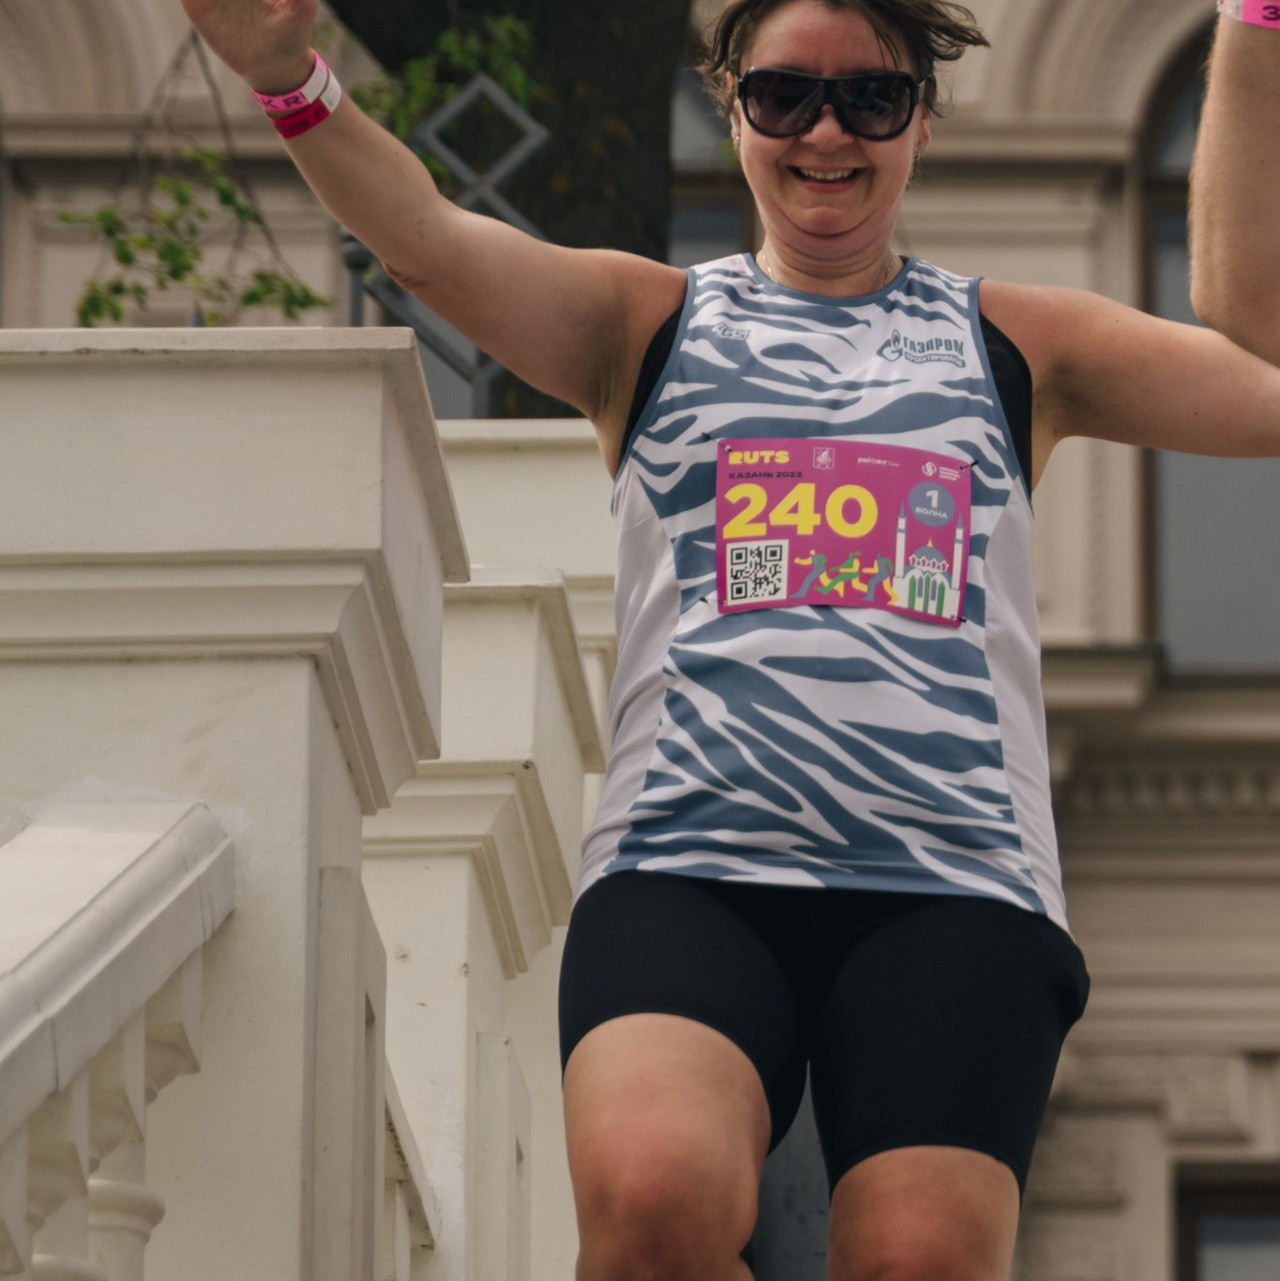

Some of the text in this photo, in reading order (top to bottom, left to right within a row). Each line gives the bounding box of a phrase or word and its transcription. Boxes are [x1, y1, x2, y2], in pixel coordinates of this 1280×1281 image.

[903, 336, 964, 357] ГАЗПРОМ
[728, 450, 790, 465] RUTS
[728, 470, 803, 480] КАЗАНЬ 2023
[925, 489, 939, 509] 1
[722, 482, 878, 540] 240
[914, 505, 949, 520] ВОЛНА
